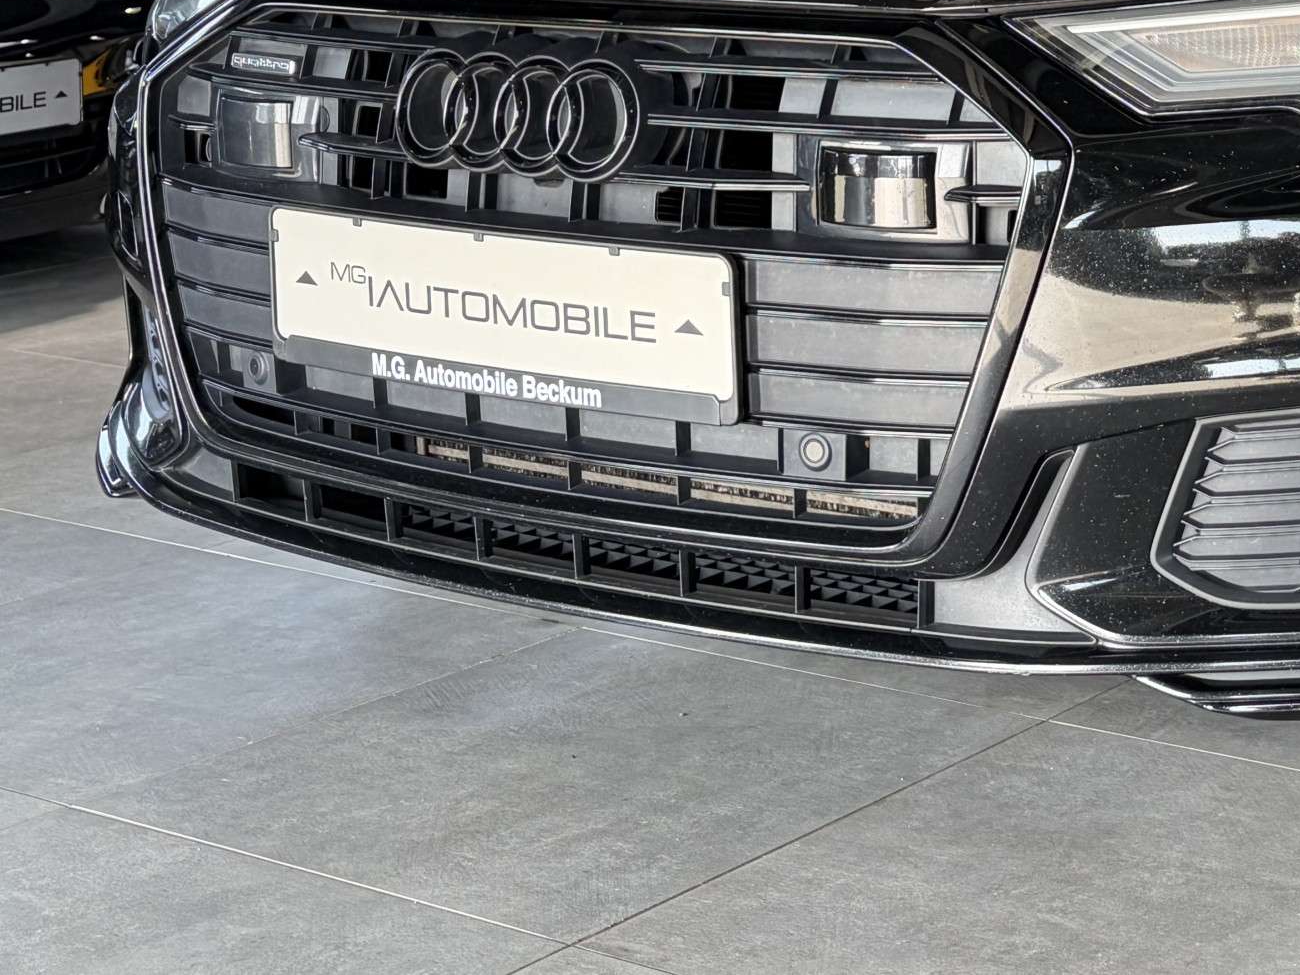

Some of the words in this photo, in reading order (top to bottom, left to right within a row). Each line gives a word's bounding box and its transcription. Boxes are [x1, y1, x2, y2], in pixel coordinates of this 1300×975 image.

[233, 56, 290, 71] quattro
[0, 91, 47, 113] BILE
[330, 261, 367, 285] MG
[371, 352, 410, 381] M.G.
[414, 359, 518, 397] Automobile
[522, 374, 602, 409] Beckum
